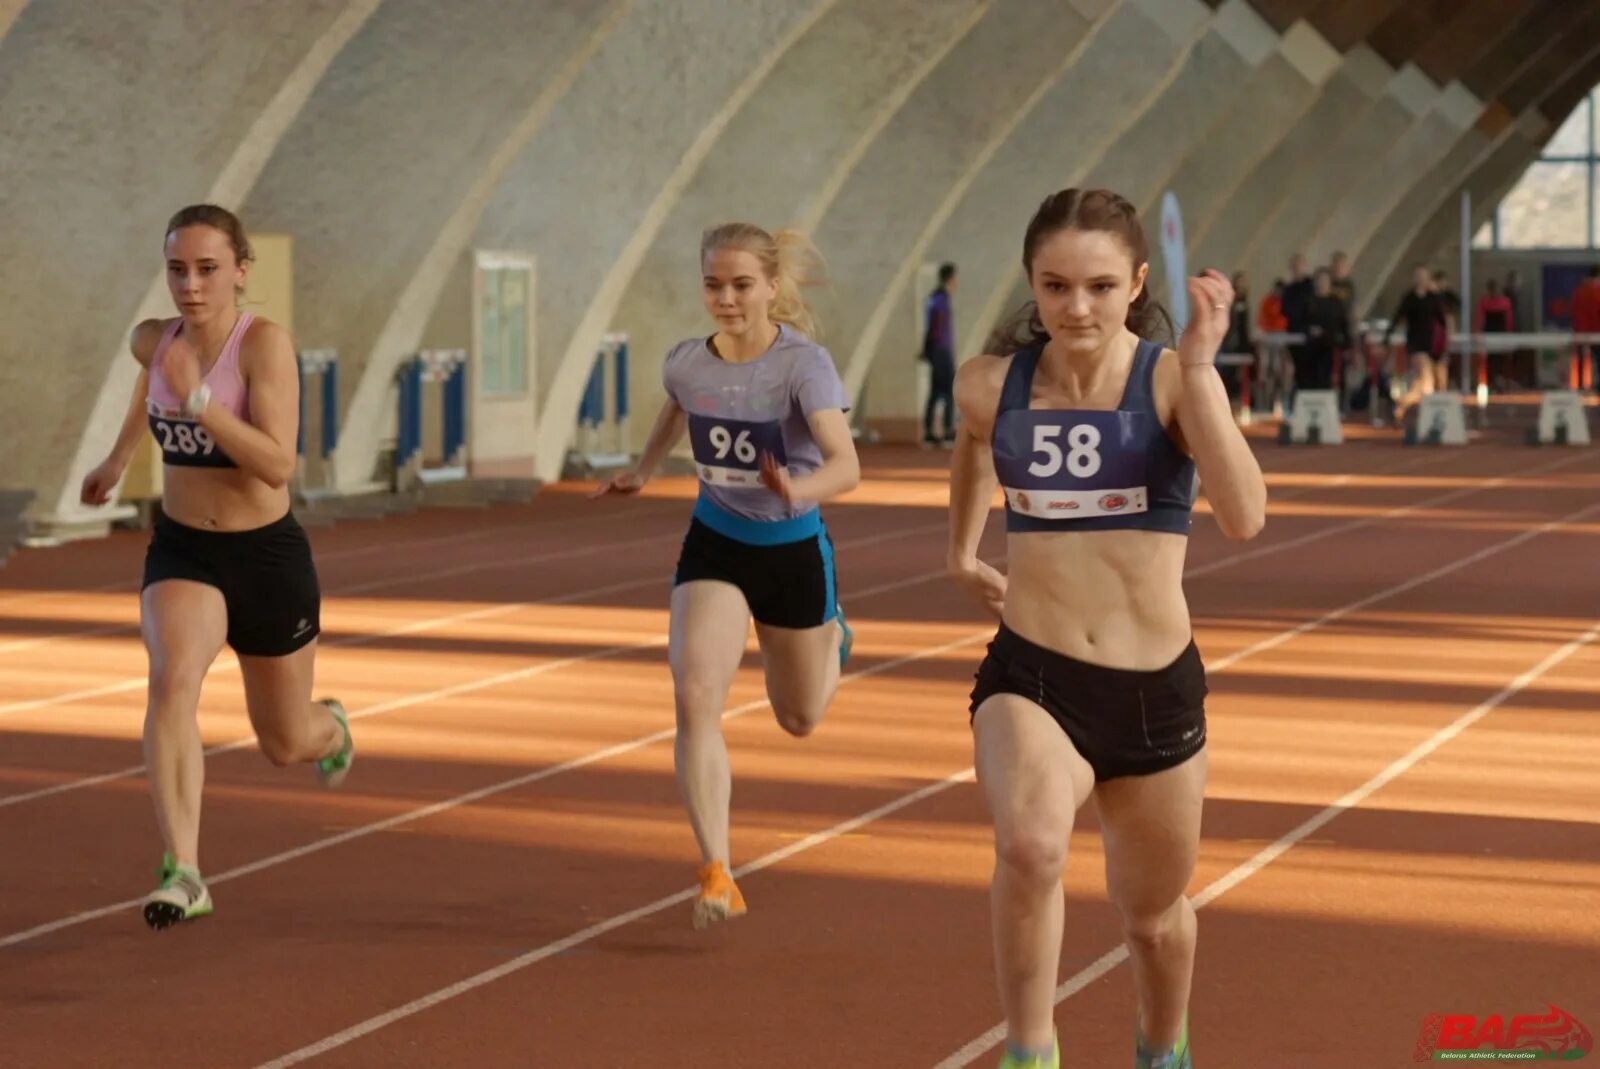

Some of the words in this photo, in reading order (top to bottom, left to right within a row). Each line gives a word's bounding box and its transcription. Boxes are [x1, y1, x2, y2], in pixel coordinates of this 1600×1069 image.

[156, 421, 215, 455] 289
[709, 425, 756, 463] 96
[1027, 424, 1102, 478] 58
